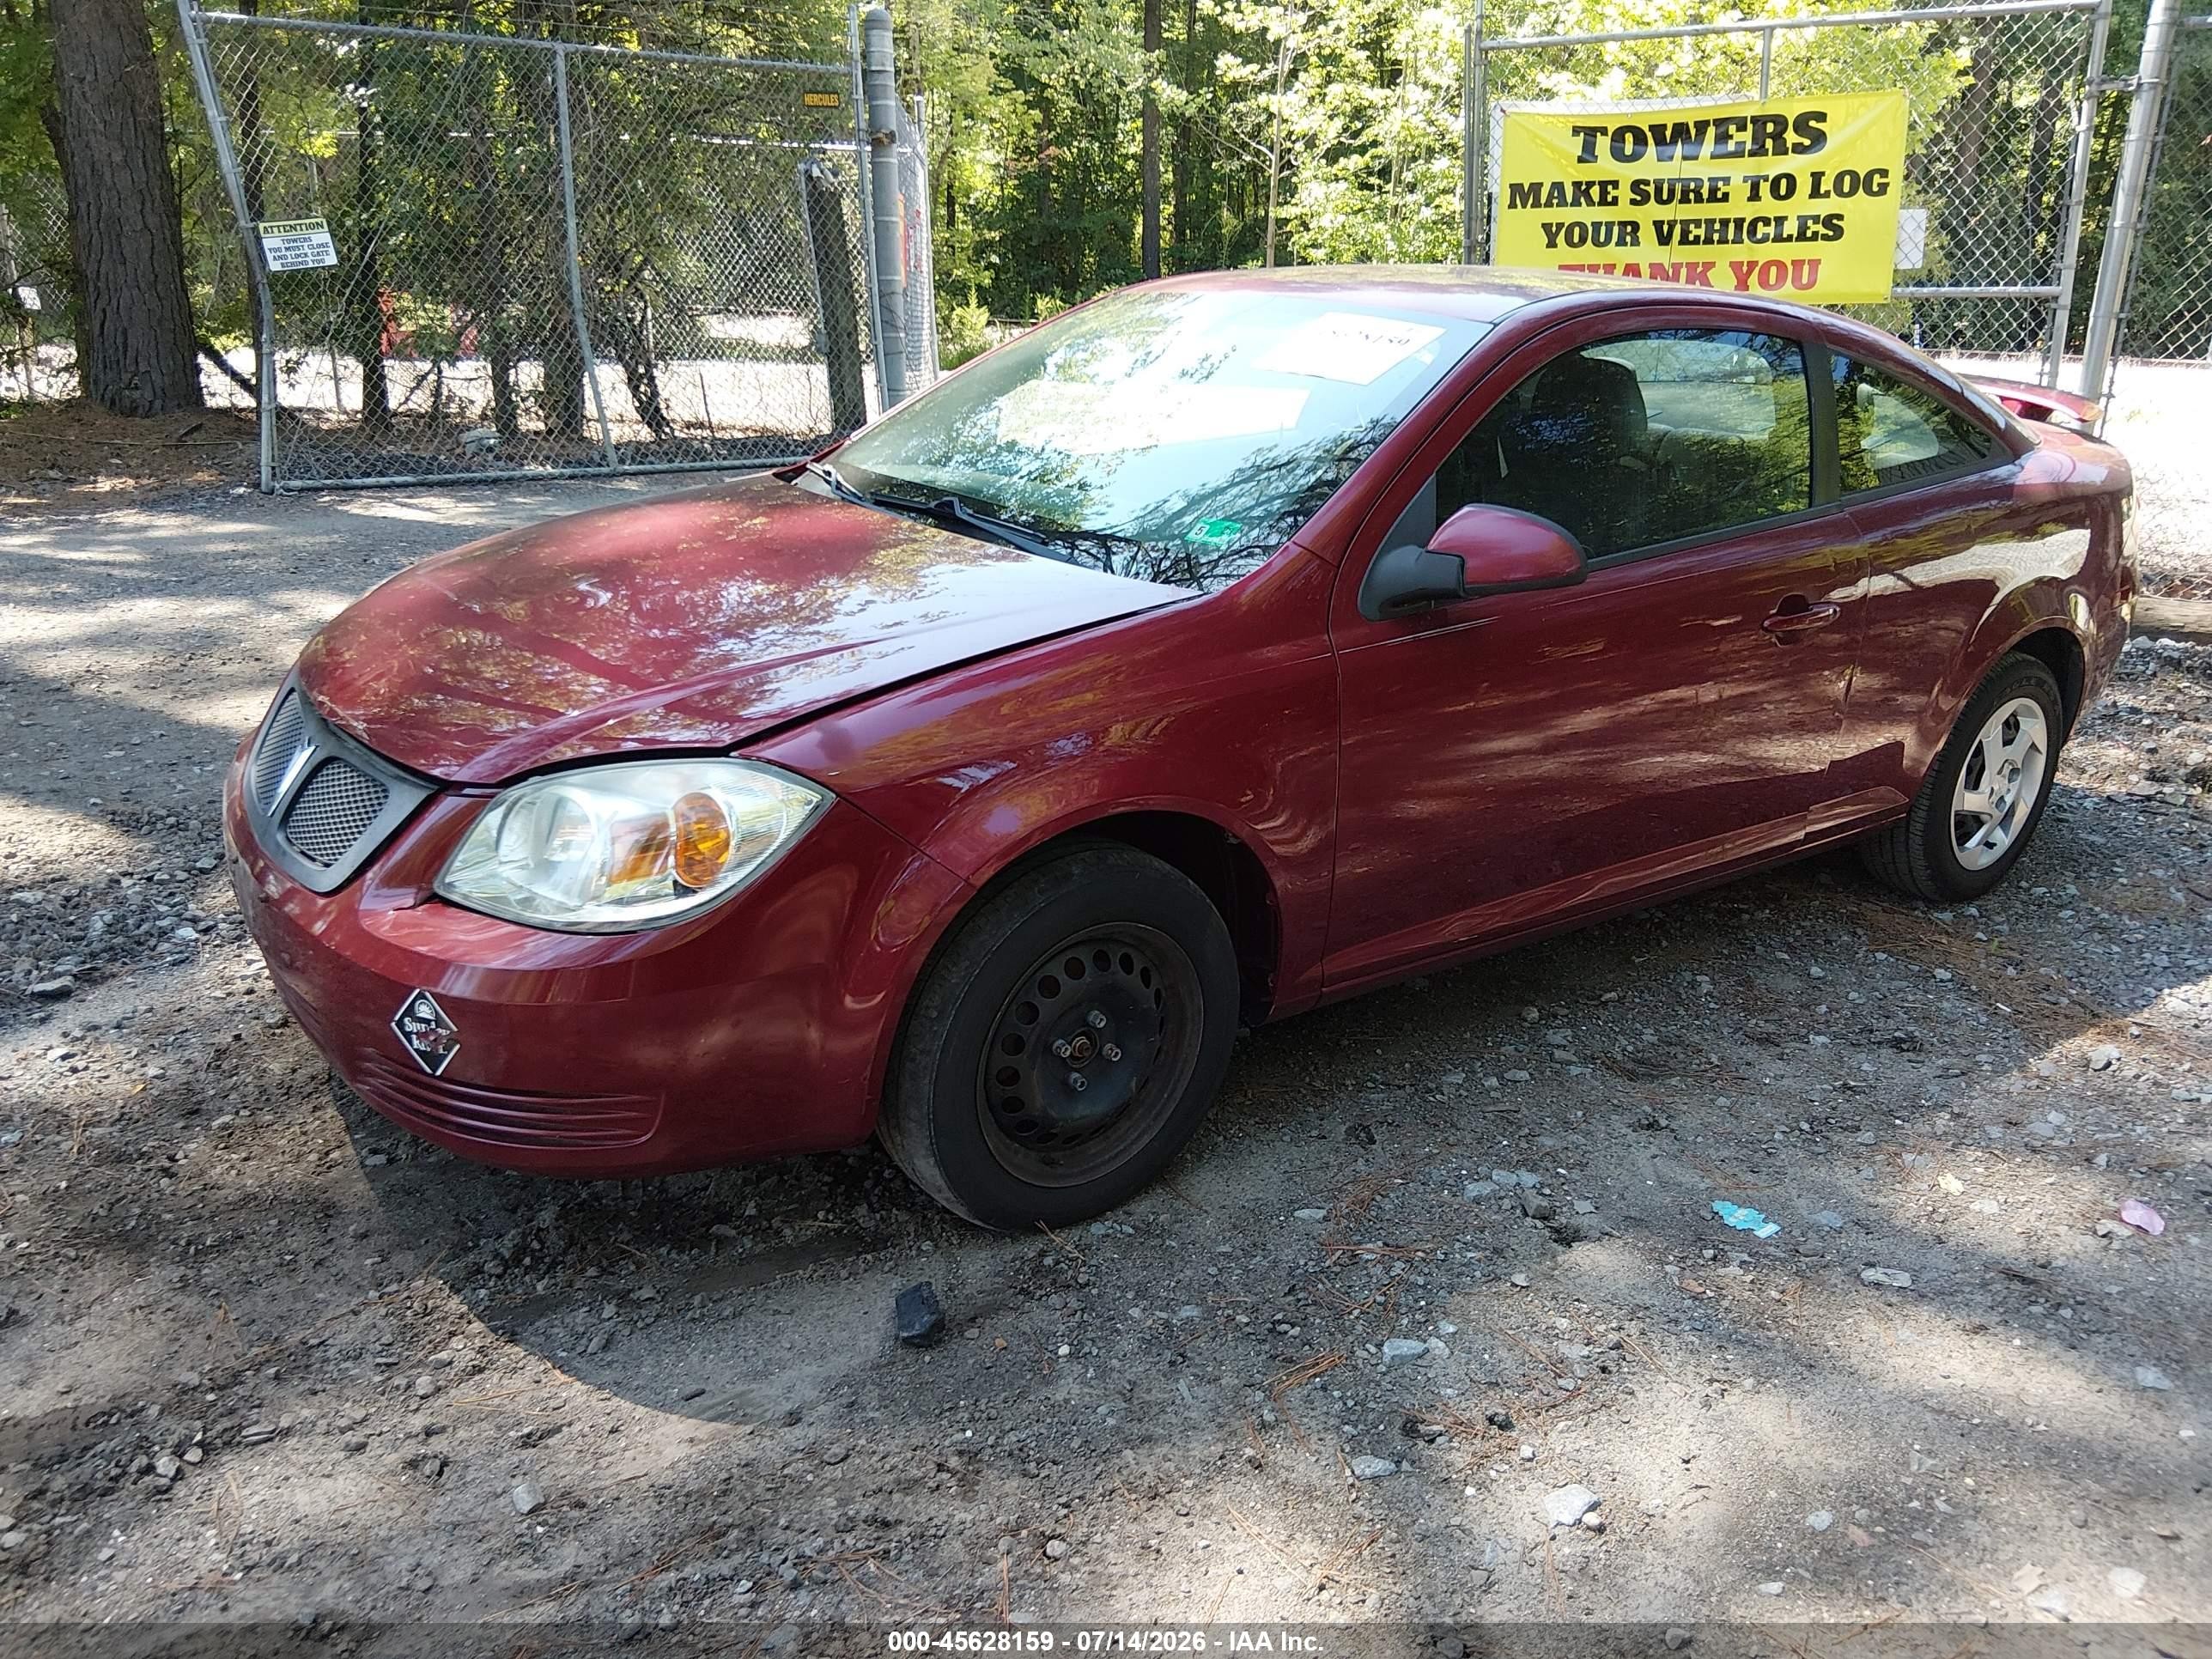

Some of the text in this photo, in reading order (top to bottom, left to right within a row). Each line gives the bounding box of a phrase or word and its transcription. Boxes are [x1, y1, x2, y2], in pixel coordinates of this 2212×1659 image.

[805, 94, 838, 106] HERCULES
[1571, 110, 1828, 164] TOWERS
[1508, 168, 1890, 210] MAKE SURE TO LOG
[264, 221, 324, 234] ATTENTION
[1541, 213, 1845, 249] YOUR VEHICLES
[281, 236, 313, 245] TOWERS
[289, 252, 310, 260] LOCK
[1558, 258, 1821, 291] ANK YOU
[1195, 526, 1206, 536] 5
